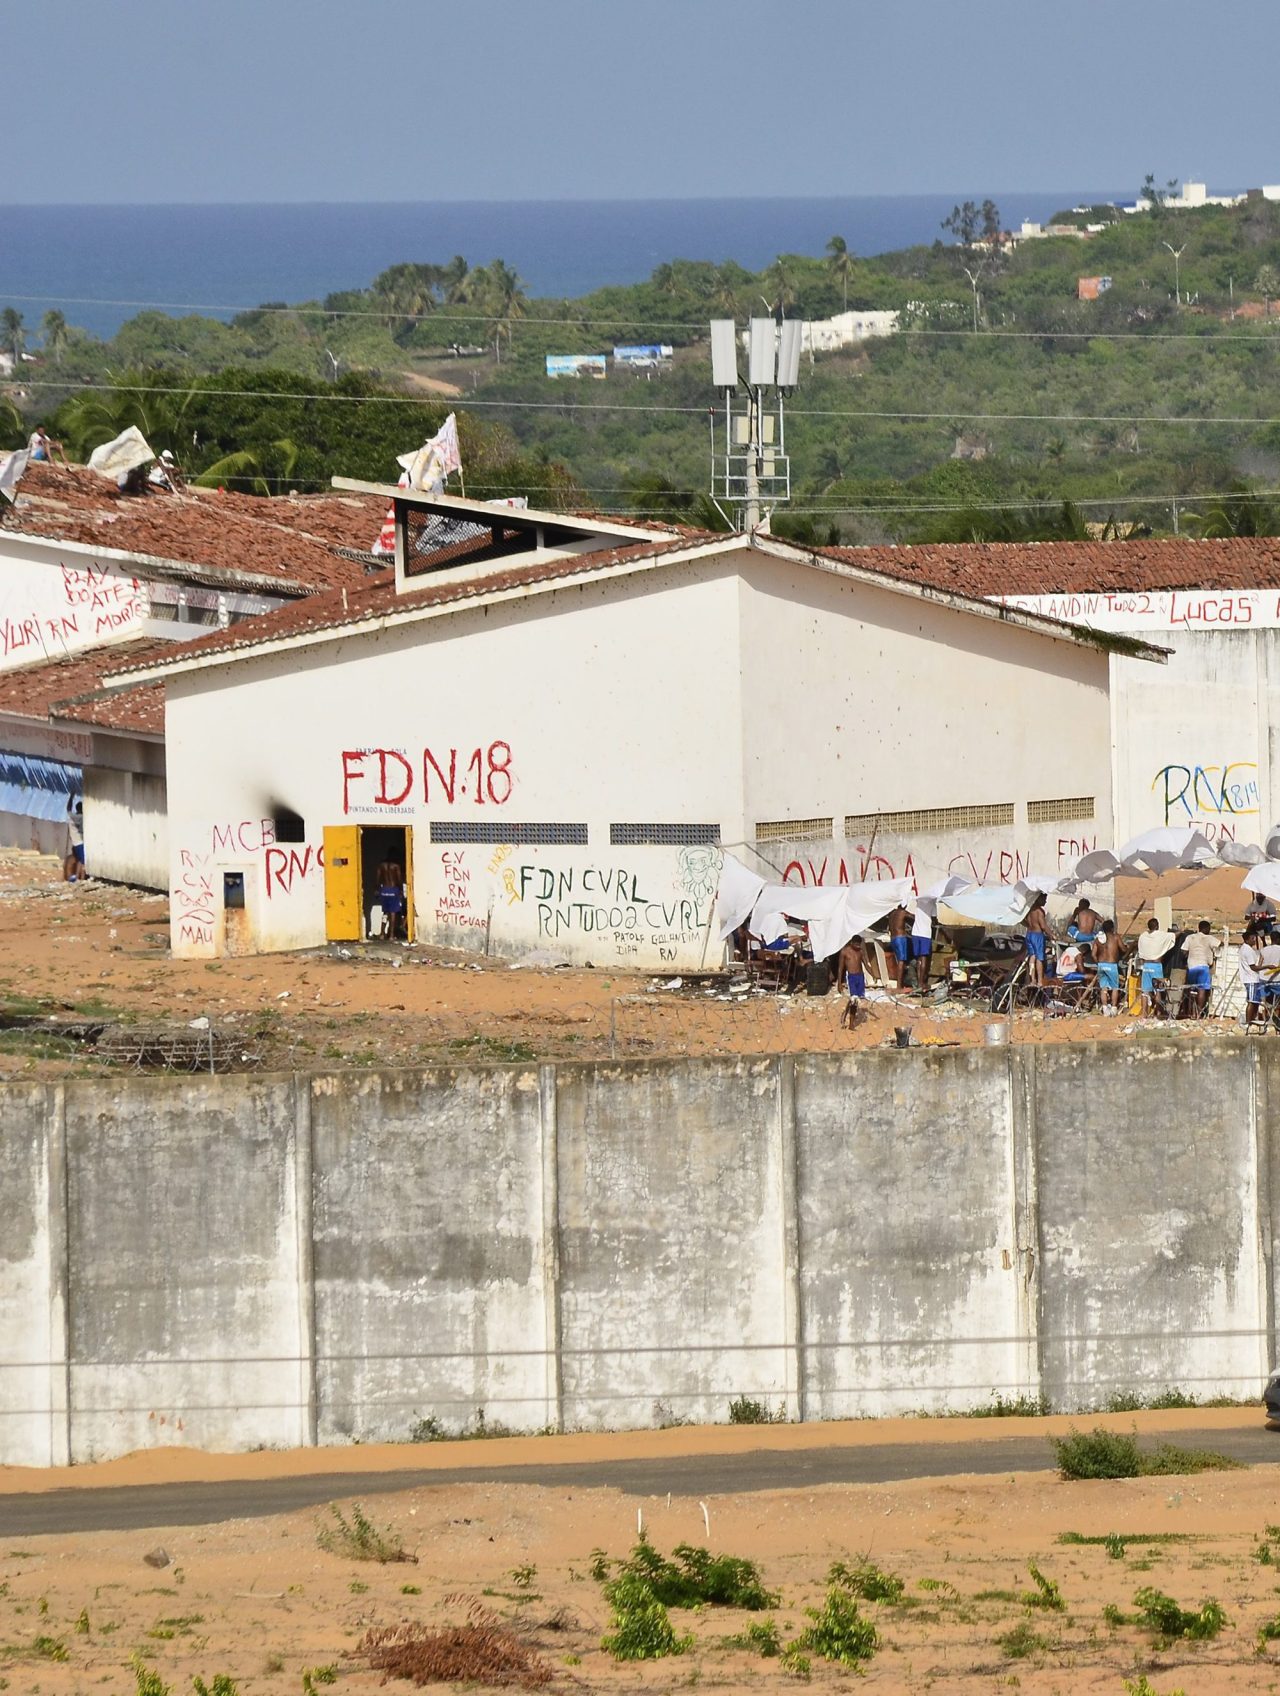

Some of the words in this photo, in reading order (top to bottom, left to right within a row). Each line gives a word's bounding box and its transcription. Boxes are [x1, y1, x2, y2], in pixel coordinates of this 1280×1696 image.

[444, 865, 471, 881] FDN
[448, 883, 467, 898] RN
[439, 896, 472, 910] MASSA
